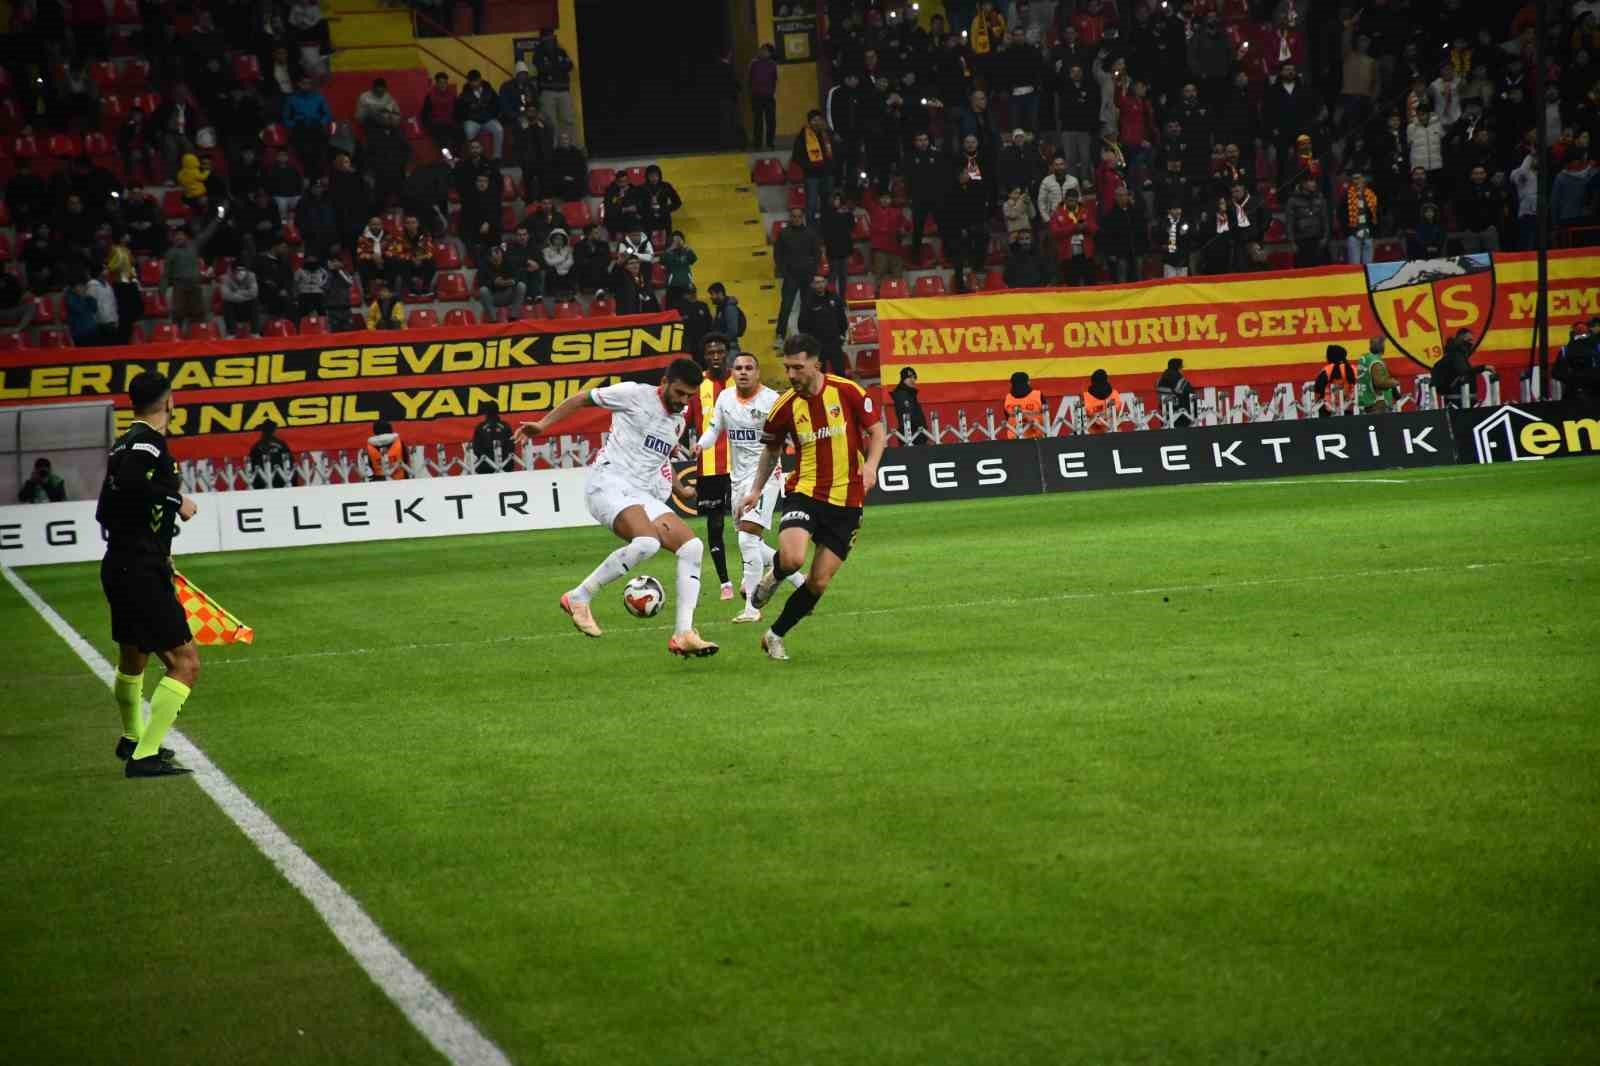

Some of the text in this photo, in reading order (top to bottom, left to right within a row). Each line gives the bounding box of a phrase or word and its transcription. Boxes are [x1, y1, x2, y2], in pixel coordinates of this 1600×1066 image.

[891, 304, 1363, 356] KAVGAM, ONURUM, CEFAM
[1392, 283, 1480, 338] KS
[200, 395, 381, 436] NASIL
[877, 425, 1439, 493] GES ELEKTRİK
[236, 482, 561, 533] ELEKTRİ
